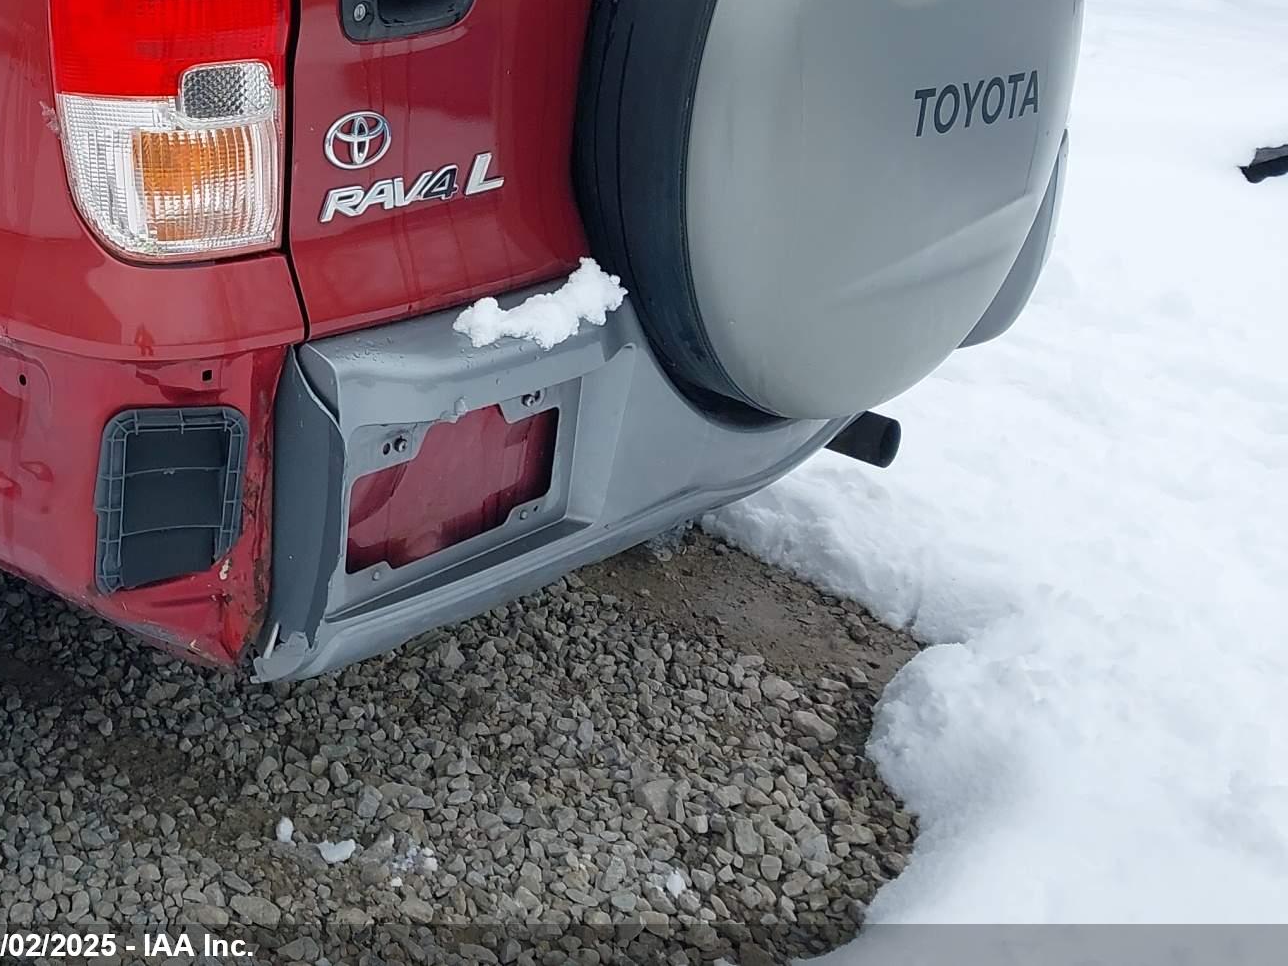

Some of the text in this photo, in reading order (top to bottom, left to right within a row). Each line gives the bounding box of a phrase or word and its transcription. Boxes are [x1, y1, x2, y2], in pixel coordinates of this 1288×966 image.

[914, 70, 1038, 137] TOYOTA
[320, 152, 505, 223] RAV4 L
